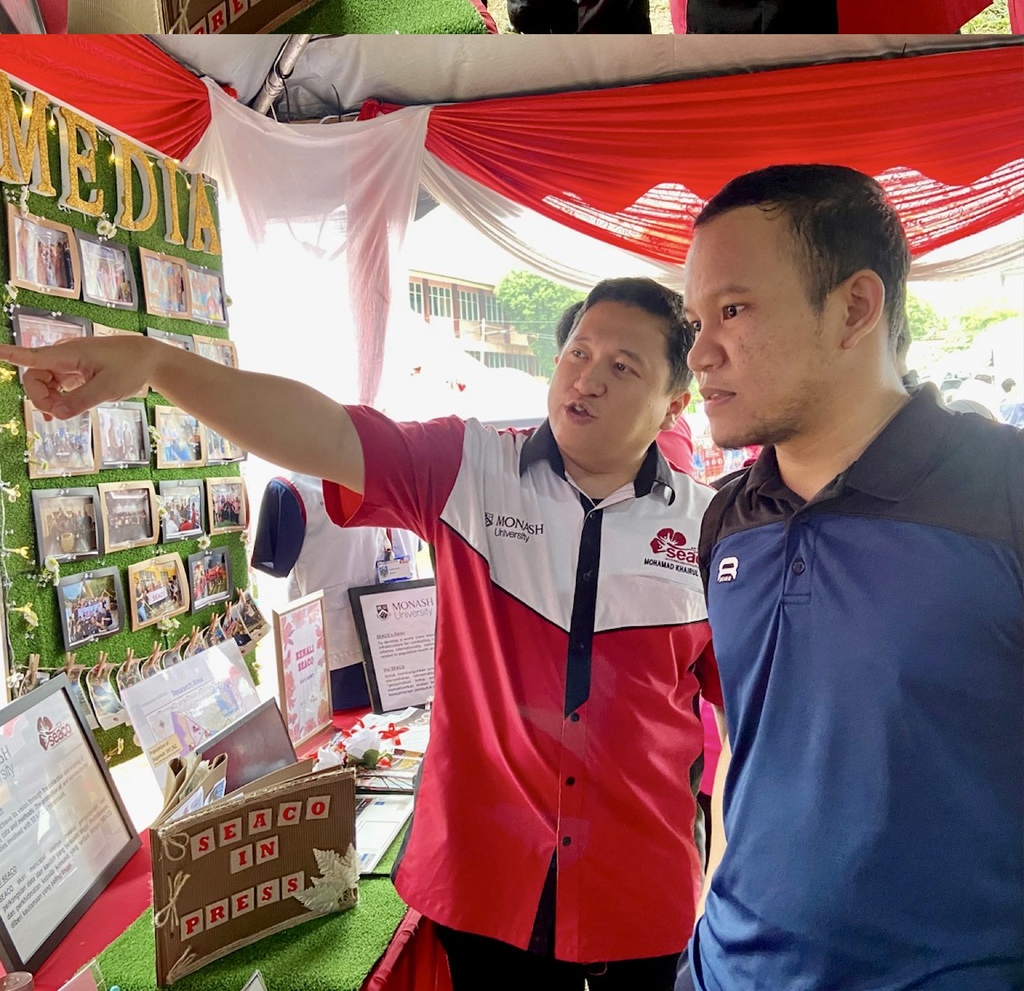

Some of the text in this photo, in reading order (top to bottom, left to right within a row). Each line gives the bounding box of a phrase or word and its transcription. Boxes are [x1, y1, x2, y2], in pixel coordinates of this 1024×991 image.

[0, 70, 222, 255] MEDIA
[495, 515, 544, 535] MONASH
[494, 528, 530, 543] University
[644, 558, 699, 577] MOHAMAD KHAIRUL
[392, 597, 434, 611] MONASH
[393, 608, 433, 620] University
[298, 657, 314, 671] SEACO
[48, 723, 72, 747] seaco
[198, 801, 326, 852] SEACO
[238, 841, 275, 866] IN
[0, 865, 17, 882] SEACO
[185, 877, 298, 935] PRESS
